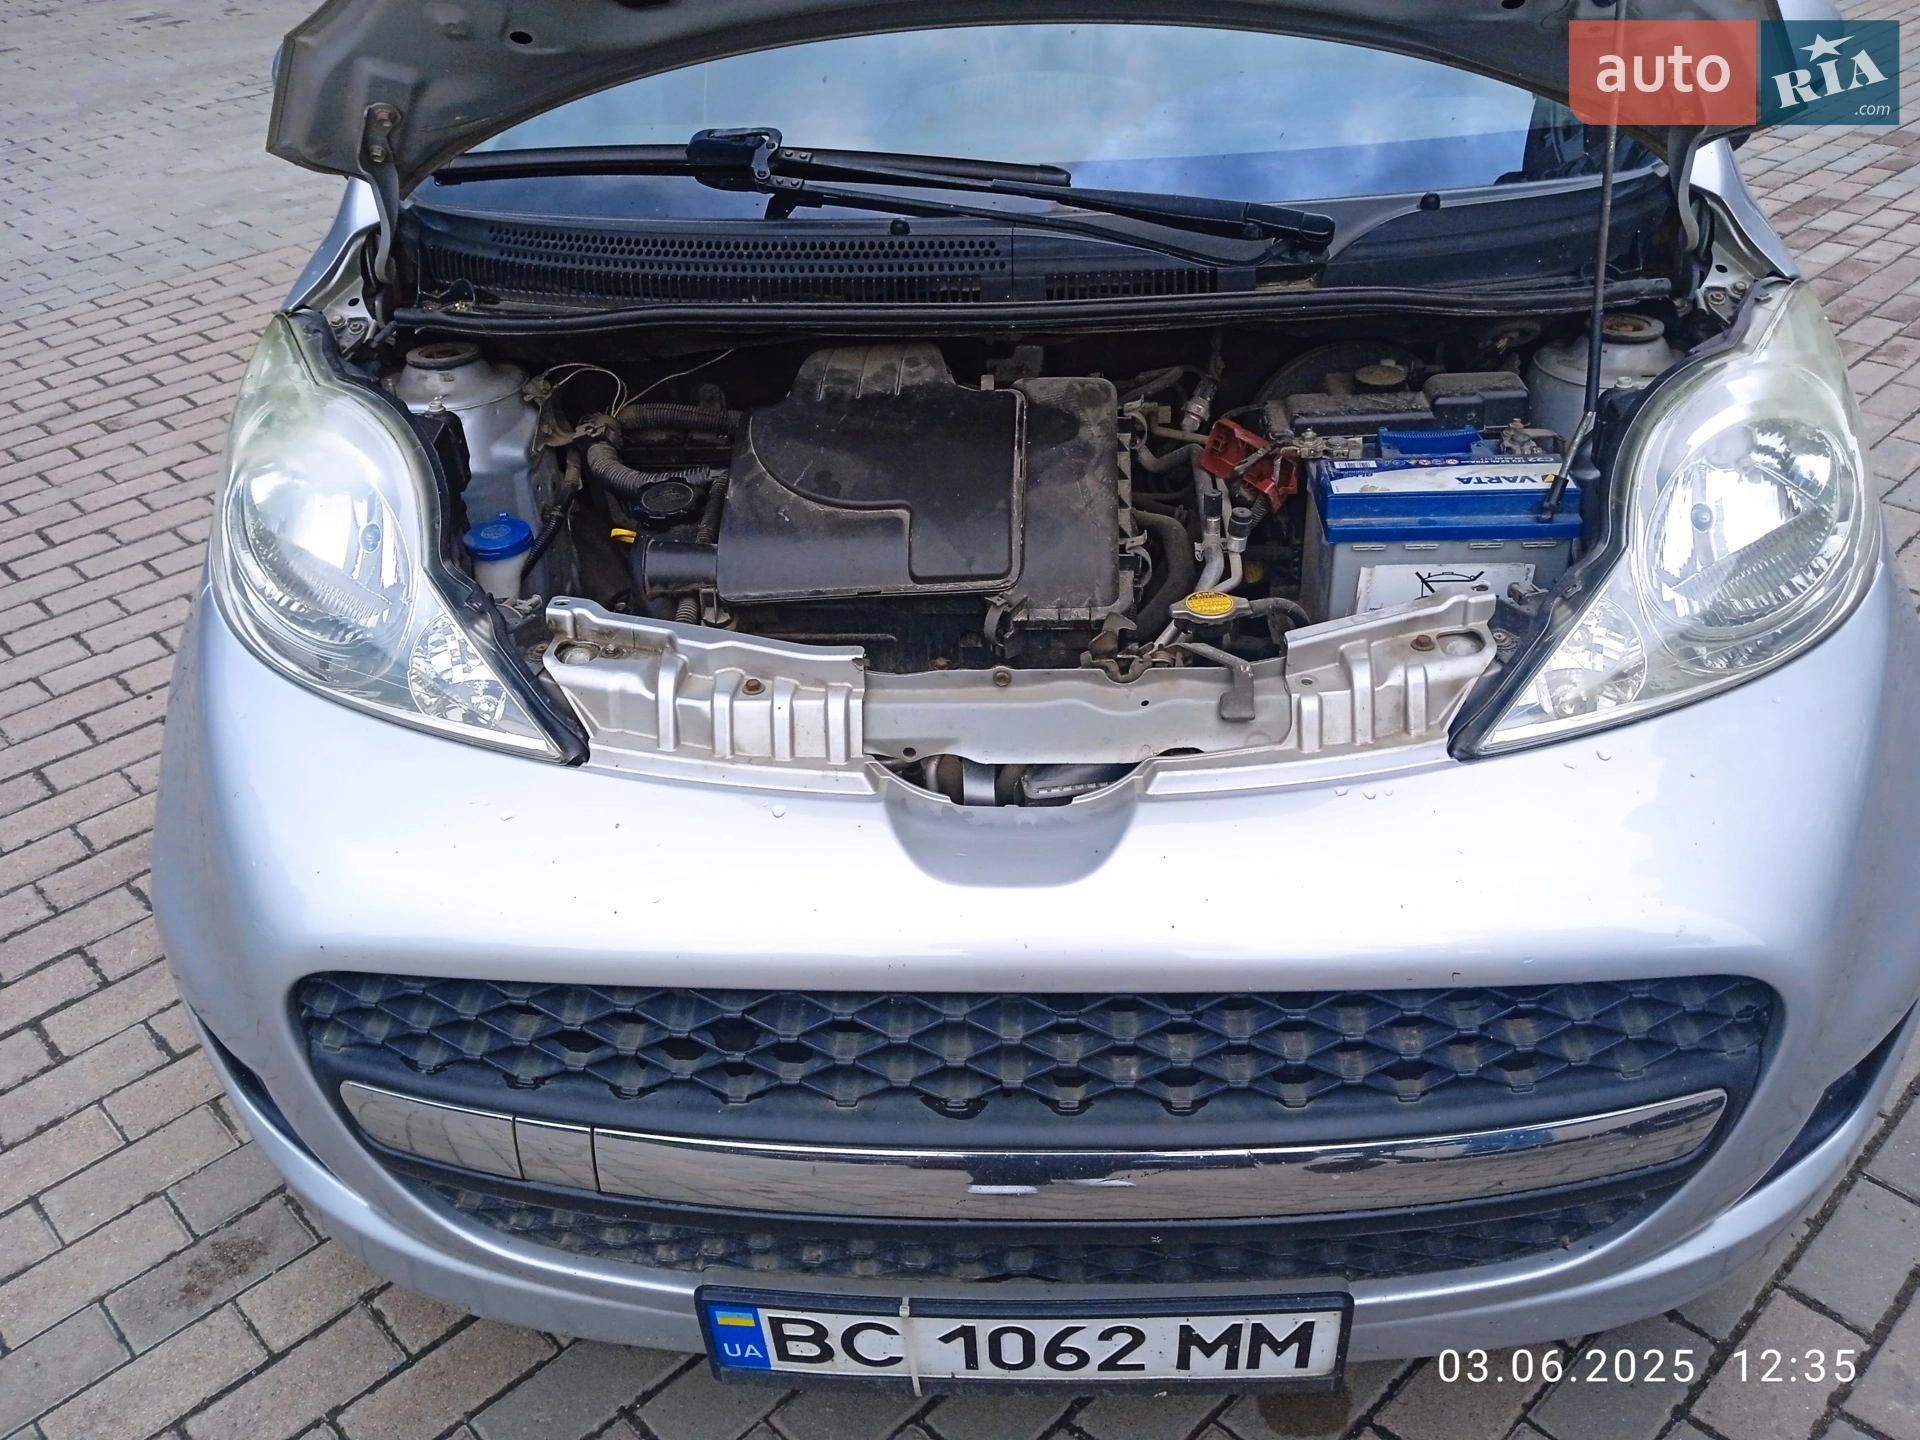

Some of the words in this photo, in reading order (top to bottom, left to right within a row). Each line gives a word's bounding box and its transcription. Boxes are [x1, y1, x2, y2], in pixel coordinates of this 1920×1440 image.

[1455, 475, 1538, 485] VARTA
[723, 1342, 763, 1358] UA
[767, 1316, 904, 1367] BC
[936, 1324, 1146, 1371] 1062
[1176, 1320, 1316, 1371] MM
